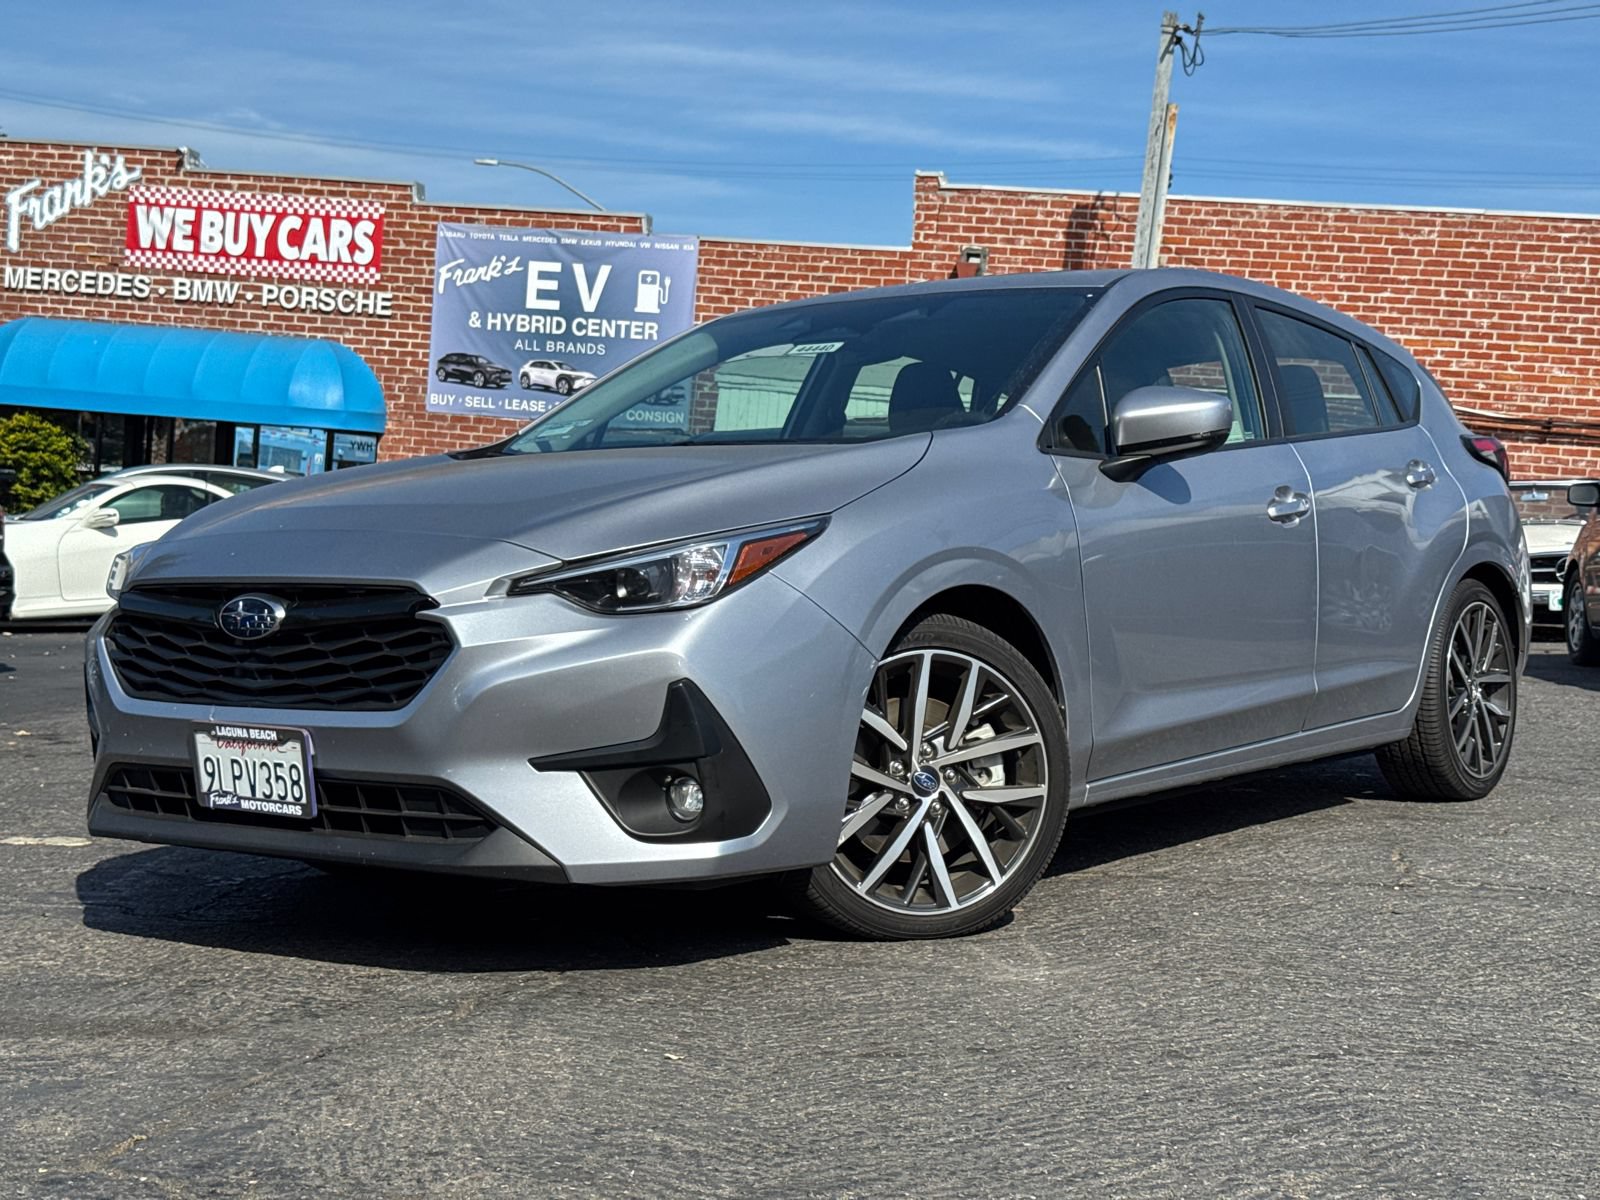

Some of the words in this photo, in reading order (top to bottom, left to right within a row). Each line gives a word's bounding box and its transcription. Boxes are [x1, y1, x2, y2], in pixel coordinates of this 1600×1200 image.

[6, 150, 142, 253] Frank's
[135, 204, 197, 252] WE
[199, 209, 276, 257] BUY
[277, 214, 376, 266] CARS
[469, 232, 495, 241] TOYOTA
[498, 234, 519, 242] TESLA
[522, 235, 557, 244] MERCEDES
[580, 239, 602, 247] LEXUS
[604, 240, 637, 249] HYUNDAI
[640, 241, 651, 249] VW
[654, 242, 680, 251] NISSAN
[4, 266, 151, 299] MERCEDES
[173, 277, 240, 305] BMW
[261, 284, 393, 316] PORSCHE
[438, 256, 524, 294] Frank's
[525, 260, 613, 313] EV
[468, 311, 482, 329] &
[487, 312, 567, 336] HYBRID
[571, 319, 659, 341] CENTER
[514, 339, 541, 352] ALL
[546, 341, 606, 356] BRANDS
[430, 393, 456, 406] BUY
[464, 395, 496, 409] SELL
[504, 398, 546, 412] LEASE
[626, 409, 685, 424] CONSIGN
[215, 725, 249, 738] LAGUNA
[249, 729, 278, 740] BEACH
[203, 756, 303, 802] 9LPV358
[241, 800, 302, 815] MOTORCARS
